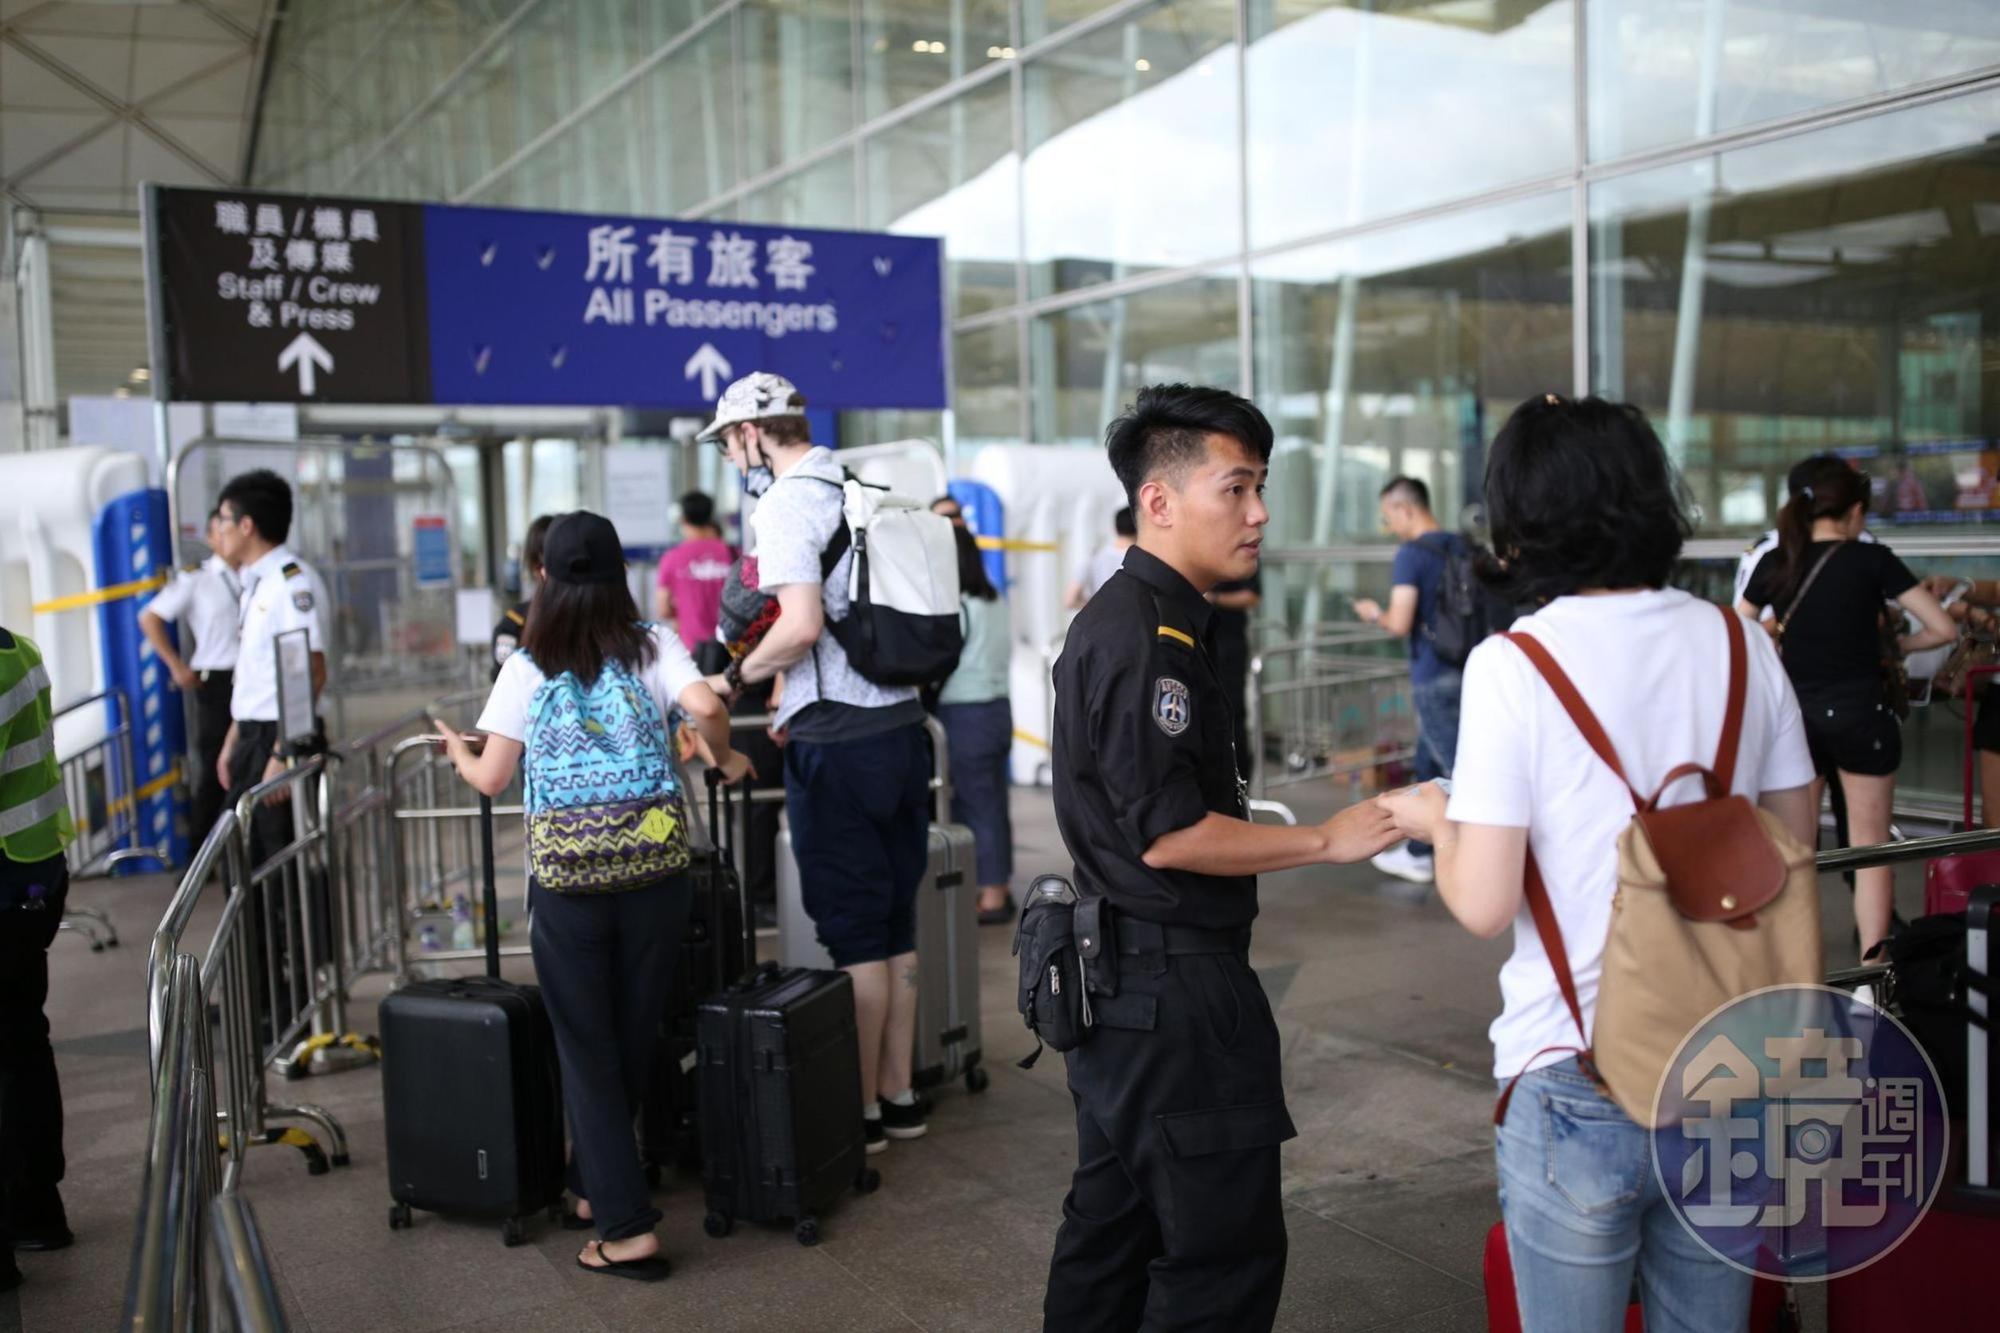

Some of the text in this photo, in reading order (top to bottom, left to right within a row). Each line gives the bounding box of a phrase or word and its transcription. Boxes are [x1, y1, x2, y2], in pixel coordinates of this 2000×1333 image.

[584, 224, 816, 291] 所有旅客
[217, 271, 286, 301] Staff
[308, 275, 381, 305] Crew
[247, 300, 355, 331] & Press
[584, 287, 838, 338] All Passengers
